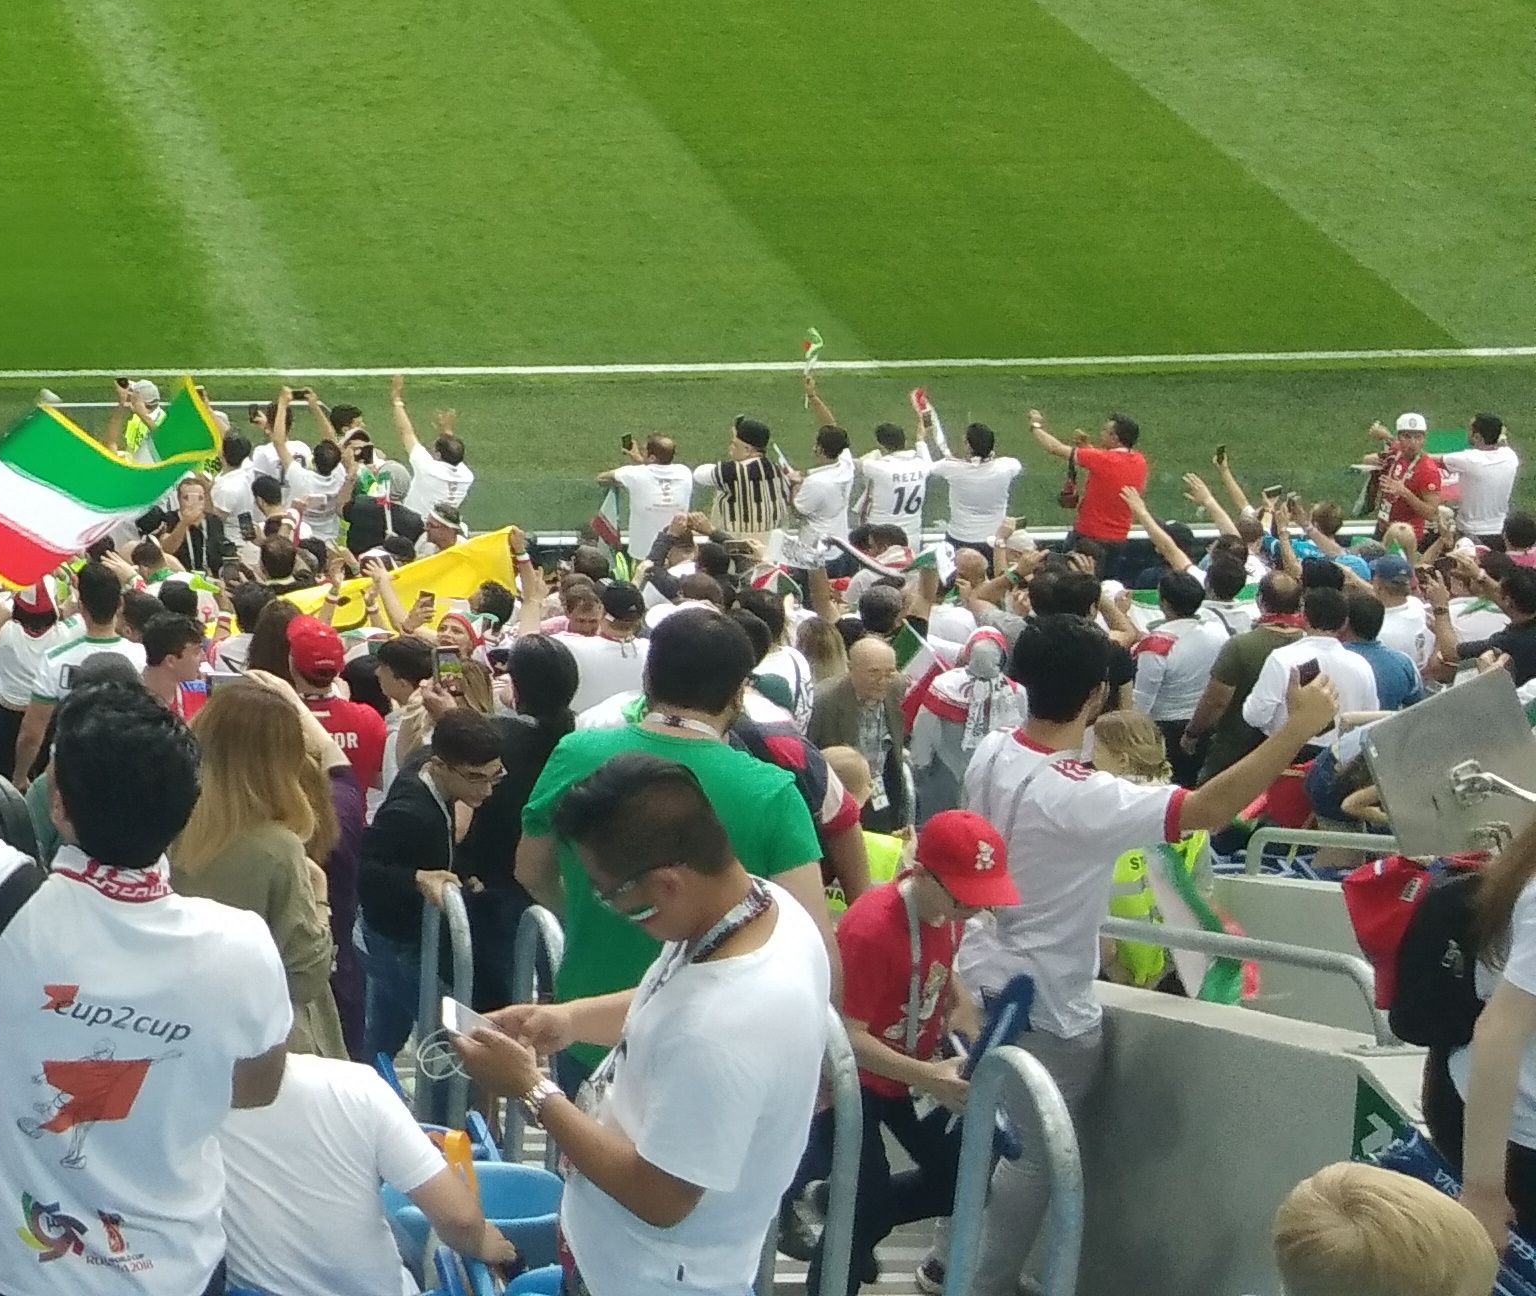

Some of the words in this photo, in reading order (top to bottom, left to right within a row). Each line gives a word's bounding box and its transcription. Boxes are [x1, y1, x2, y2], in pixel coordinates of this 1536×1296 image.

[893, 470, 924, 483] REZA
[893, 484, 922, 516] 16
[52, 1000, 192, 1043] cup2cup
